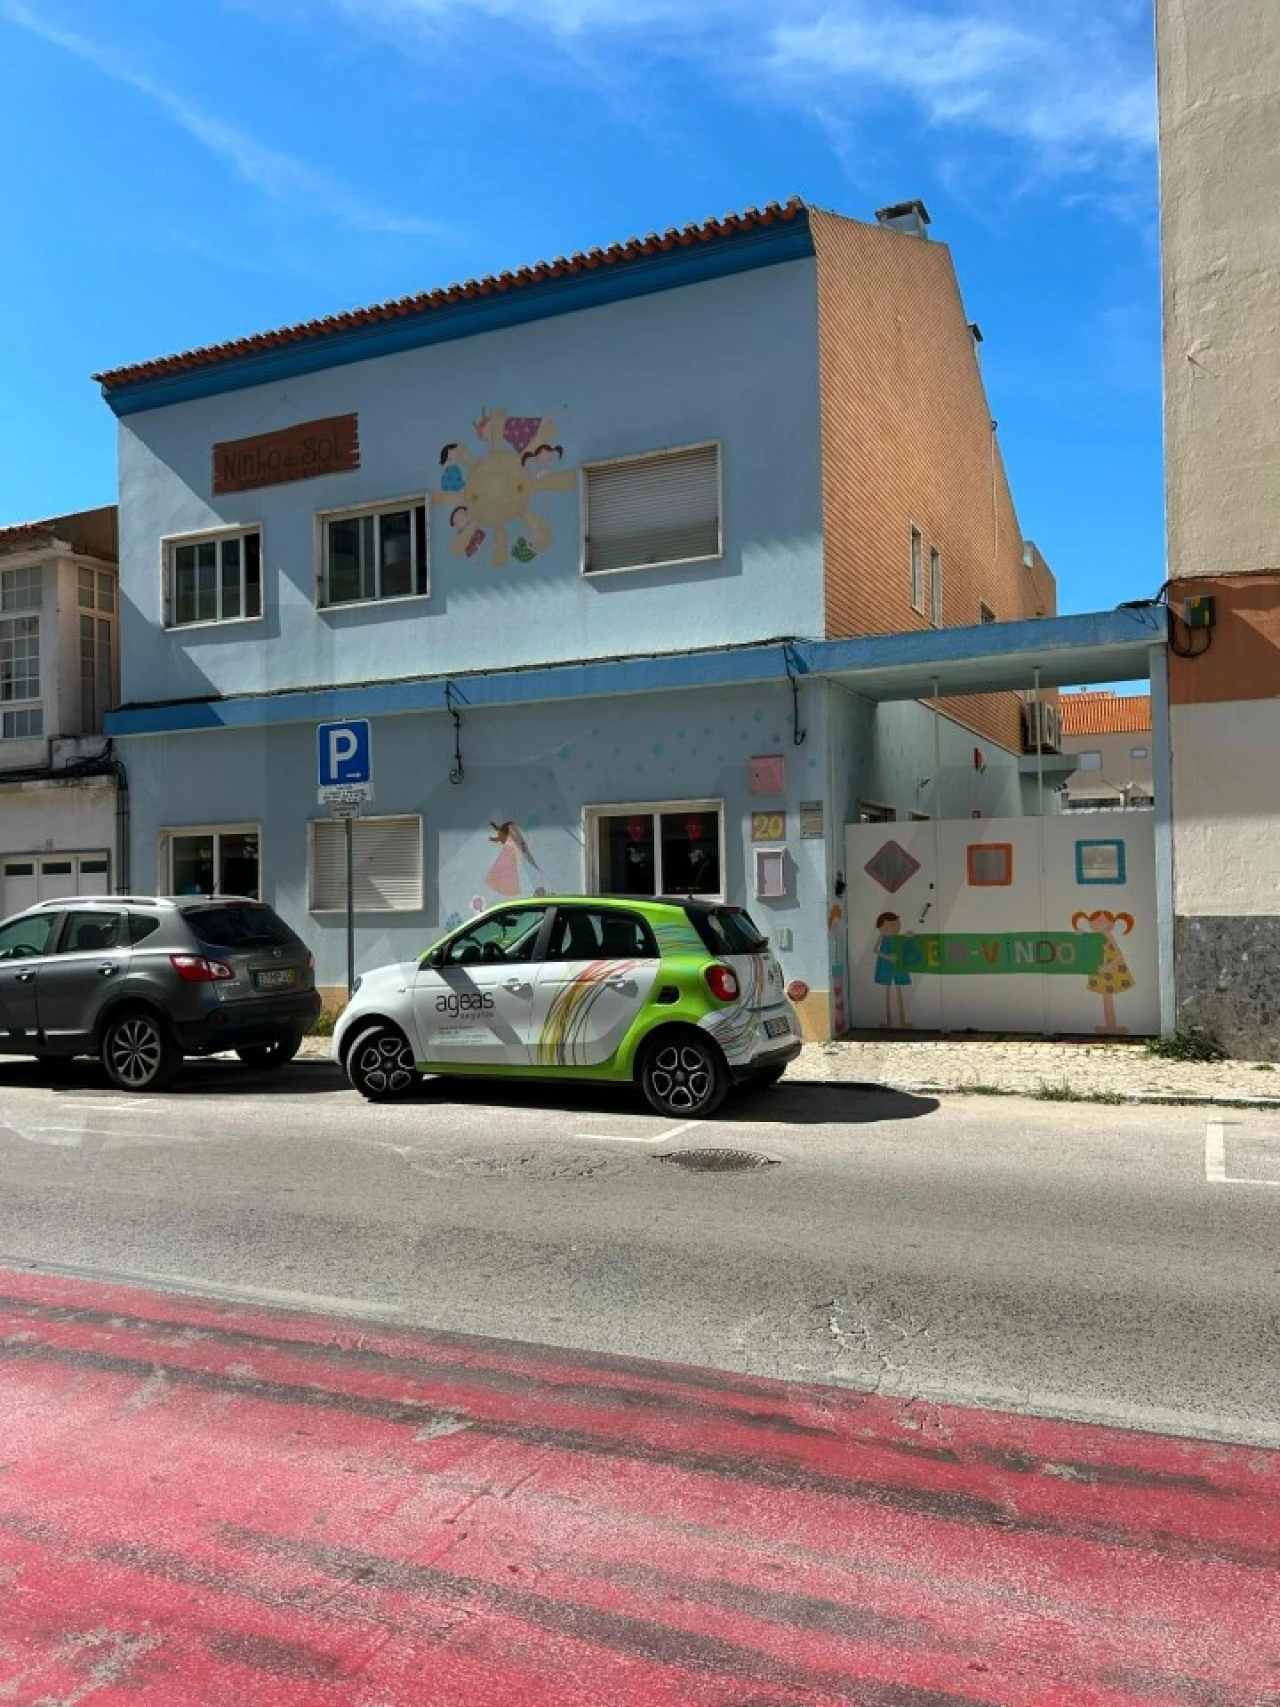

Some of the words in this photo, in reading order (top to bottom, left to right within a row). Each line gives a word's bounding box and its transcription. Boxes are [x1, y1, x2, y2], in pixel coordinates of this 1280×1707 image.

[329, 729, 358, 780] P
[753, 813, 783, 840] 20
[435, 991, 495, 1018] ageas
